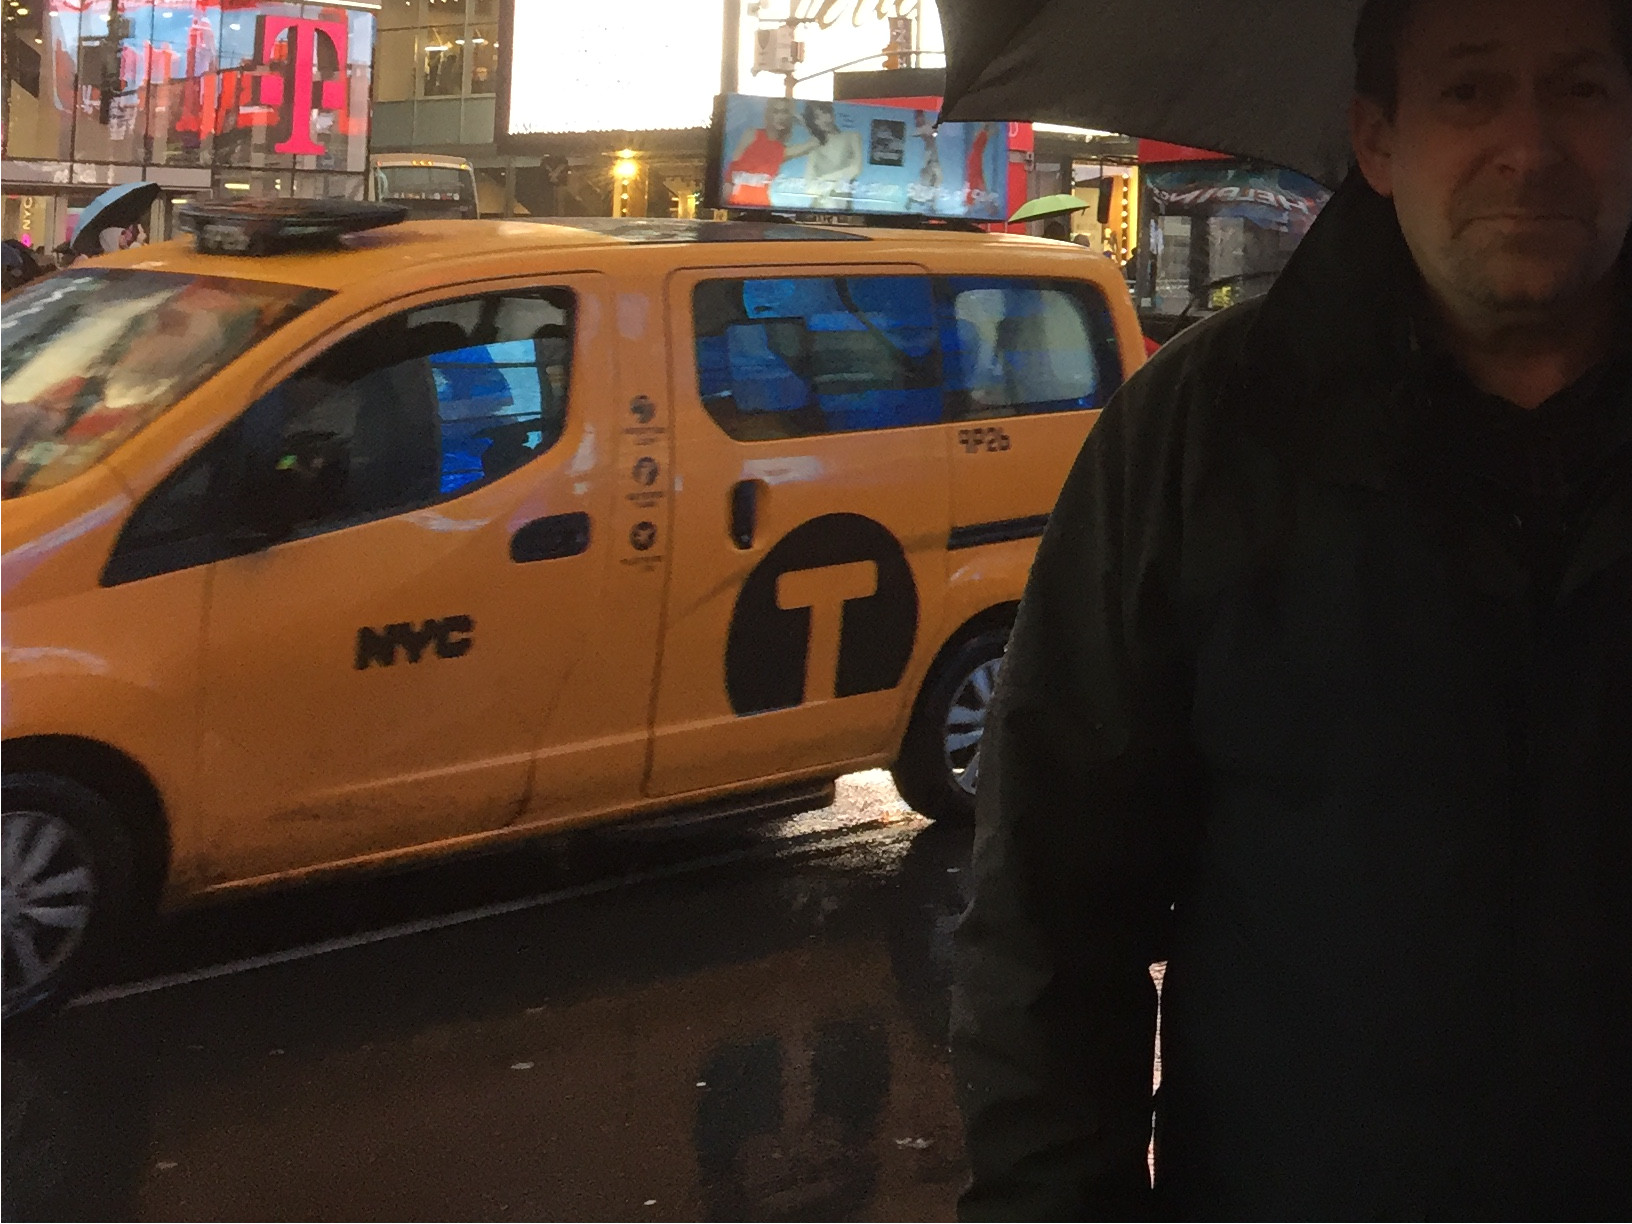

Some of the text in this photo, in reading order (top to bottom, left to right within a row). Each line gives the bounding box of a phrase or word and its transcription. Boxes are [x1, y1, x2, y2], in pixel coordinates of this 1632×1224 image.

[258, 14, 349, 155] T
[22, 196, 34, 230] NYC
[354, 614, 476, 671] NYC
